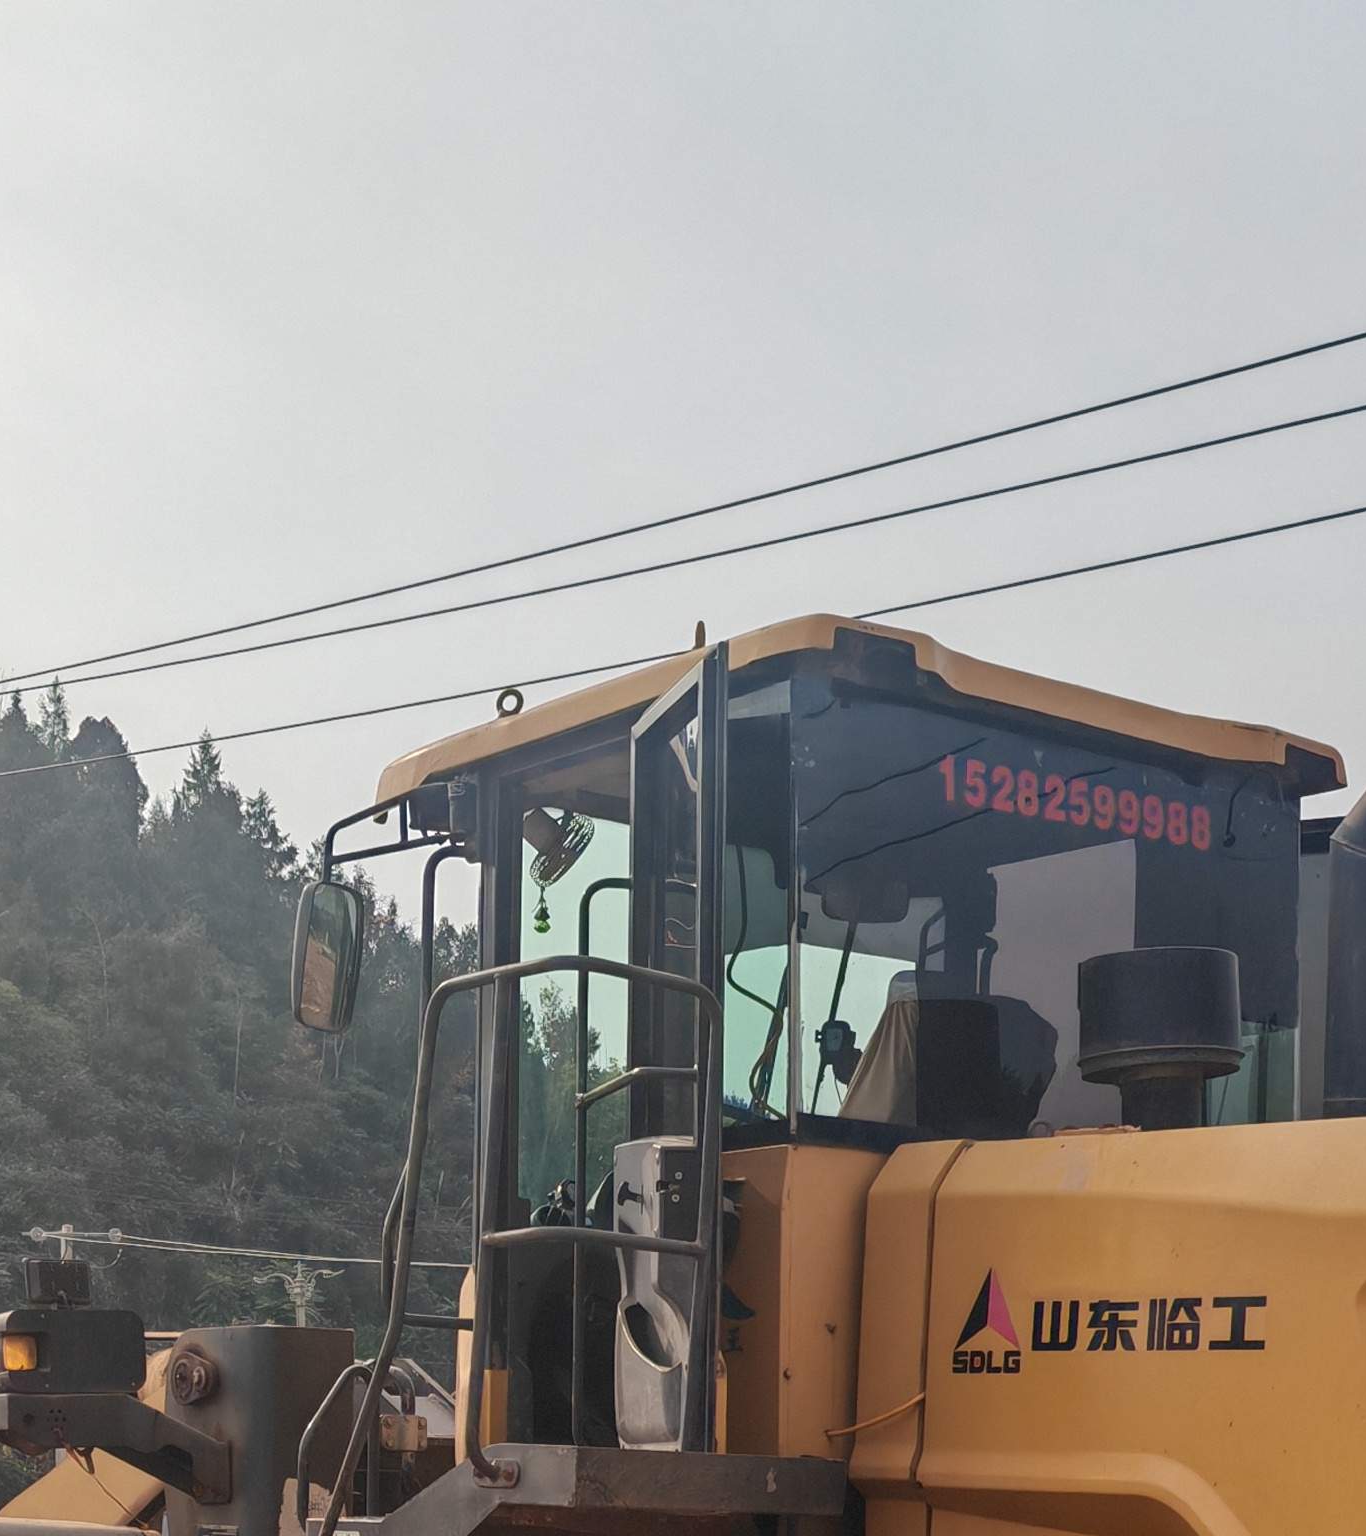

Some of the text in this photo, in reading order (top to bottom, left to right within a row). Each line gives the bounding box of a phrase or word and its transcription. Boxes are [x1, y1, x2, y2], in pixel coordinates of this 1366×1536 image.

[938, 754, 1212, 851] 15282599988
[1031, 1296, 1268, 1352] 山东临工
[952, 1350, 1021, 1374] SDLG
